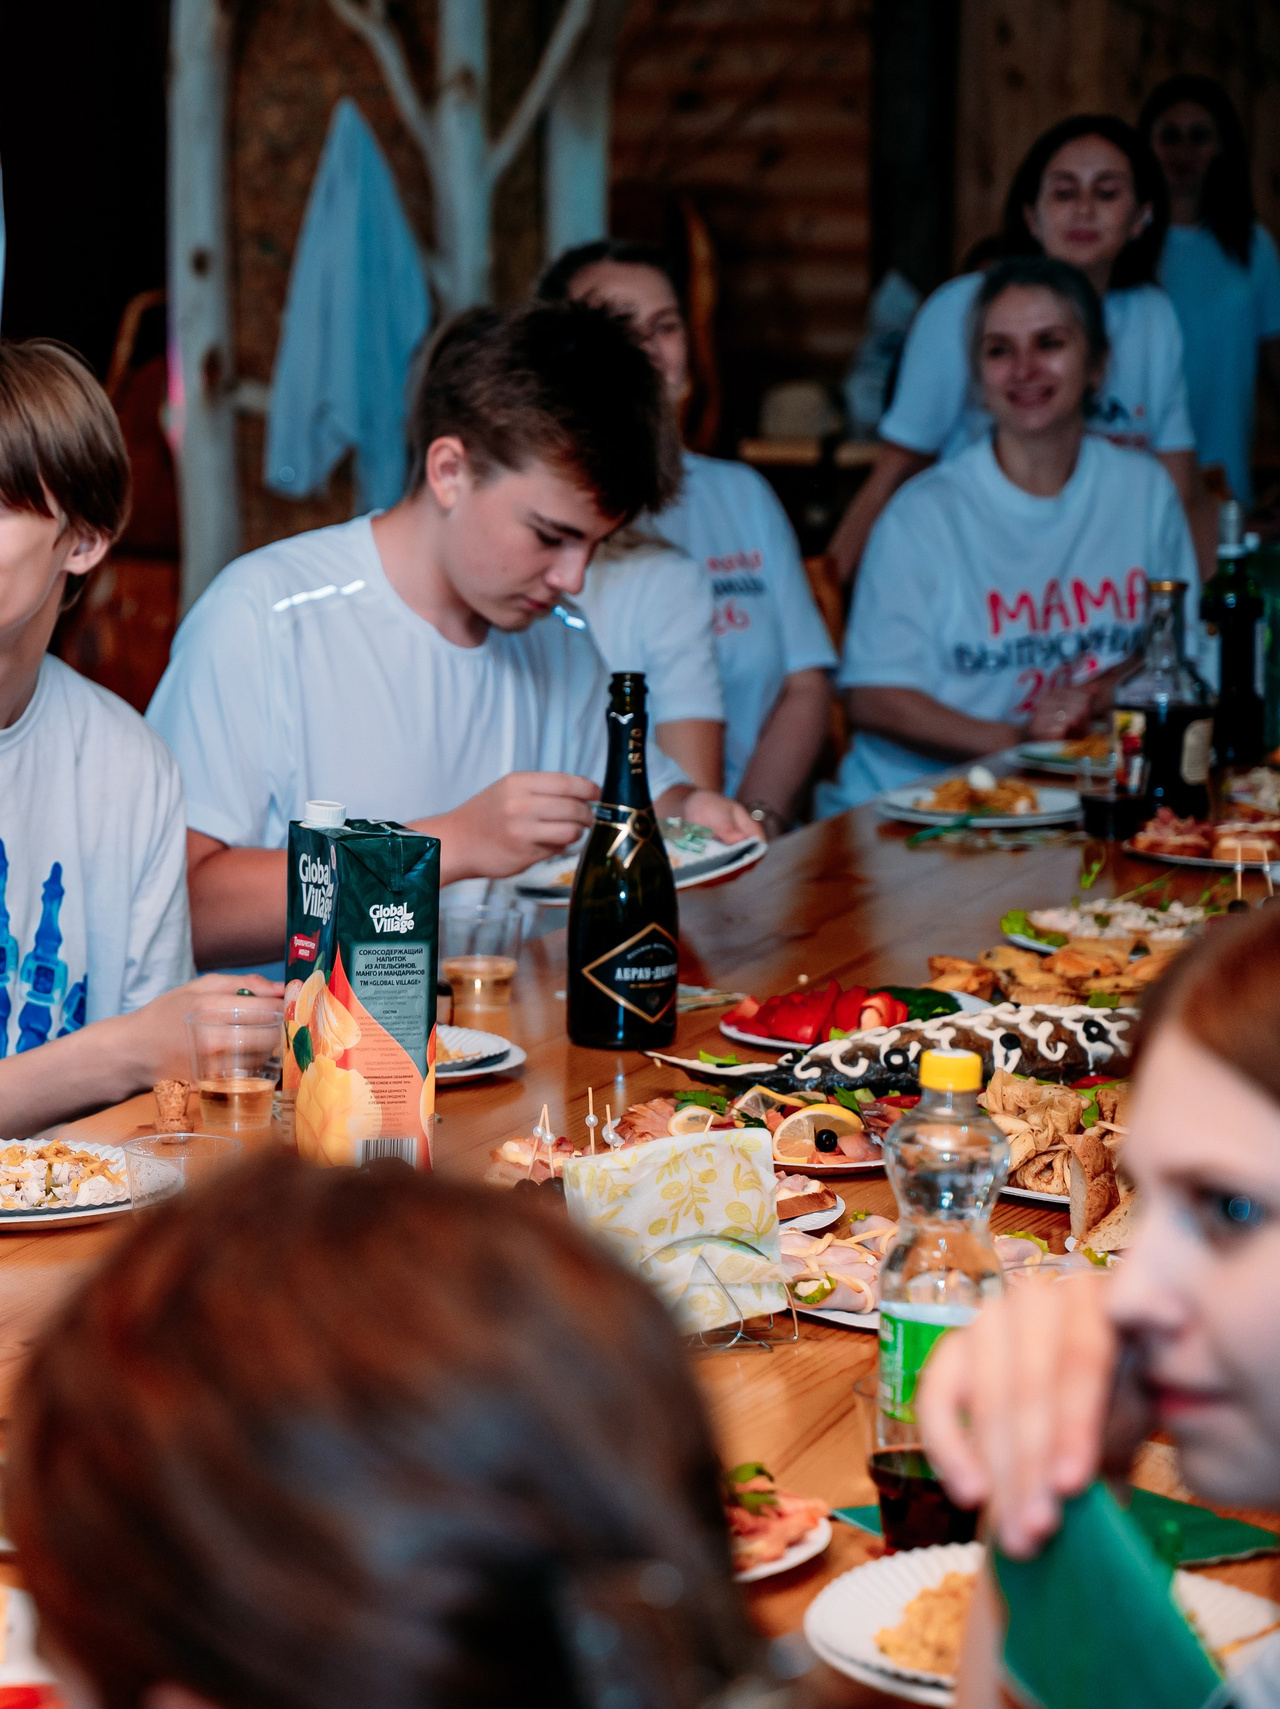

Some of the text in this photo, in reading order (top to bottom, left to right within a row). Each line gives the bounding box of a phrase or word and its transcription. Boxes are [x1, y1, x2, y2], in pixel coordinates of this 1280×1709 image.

[299, 853, 331, 885] Global
[301, 883, 333, 926] Village
[369, 902, 408, 918] Global
[372, 917, 415, 934] Village
[358, 947, 424, 956] СОКОСОДЕРЖАЩИЙ
[383, 969, 425, 977] МАНДАРИНОВ
